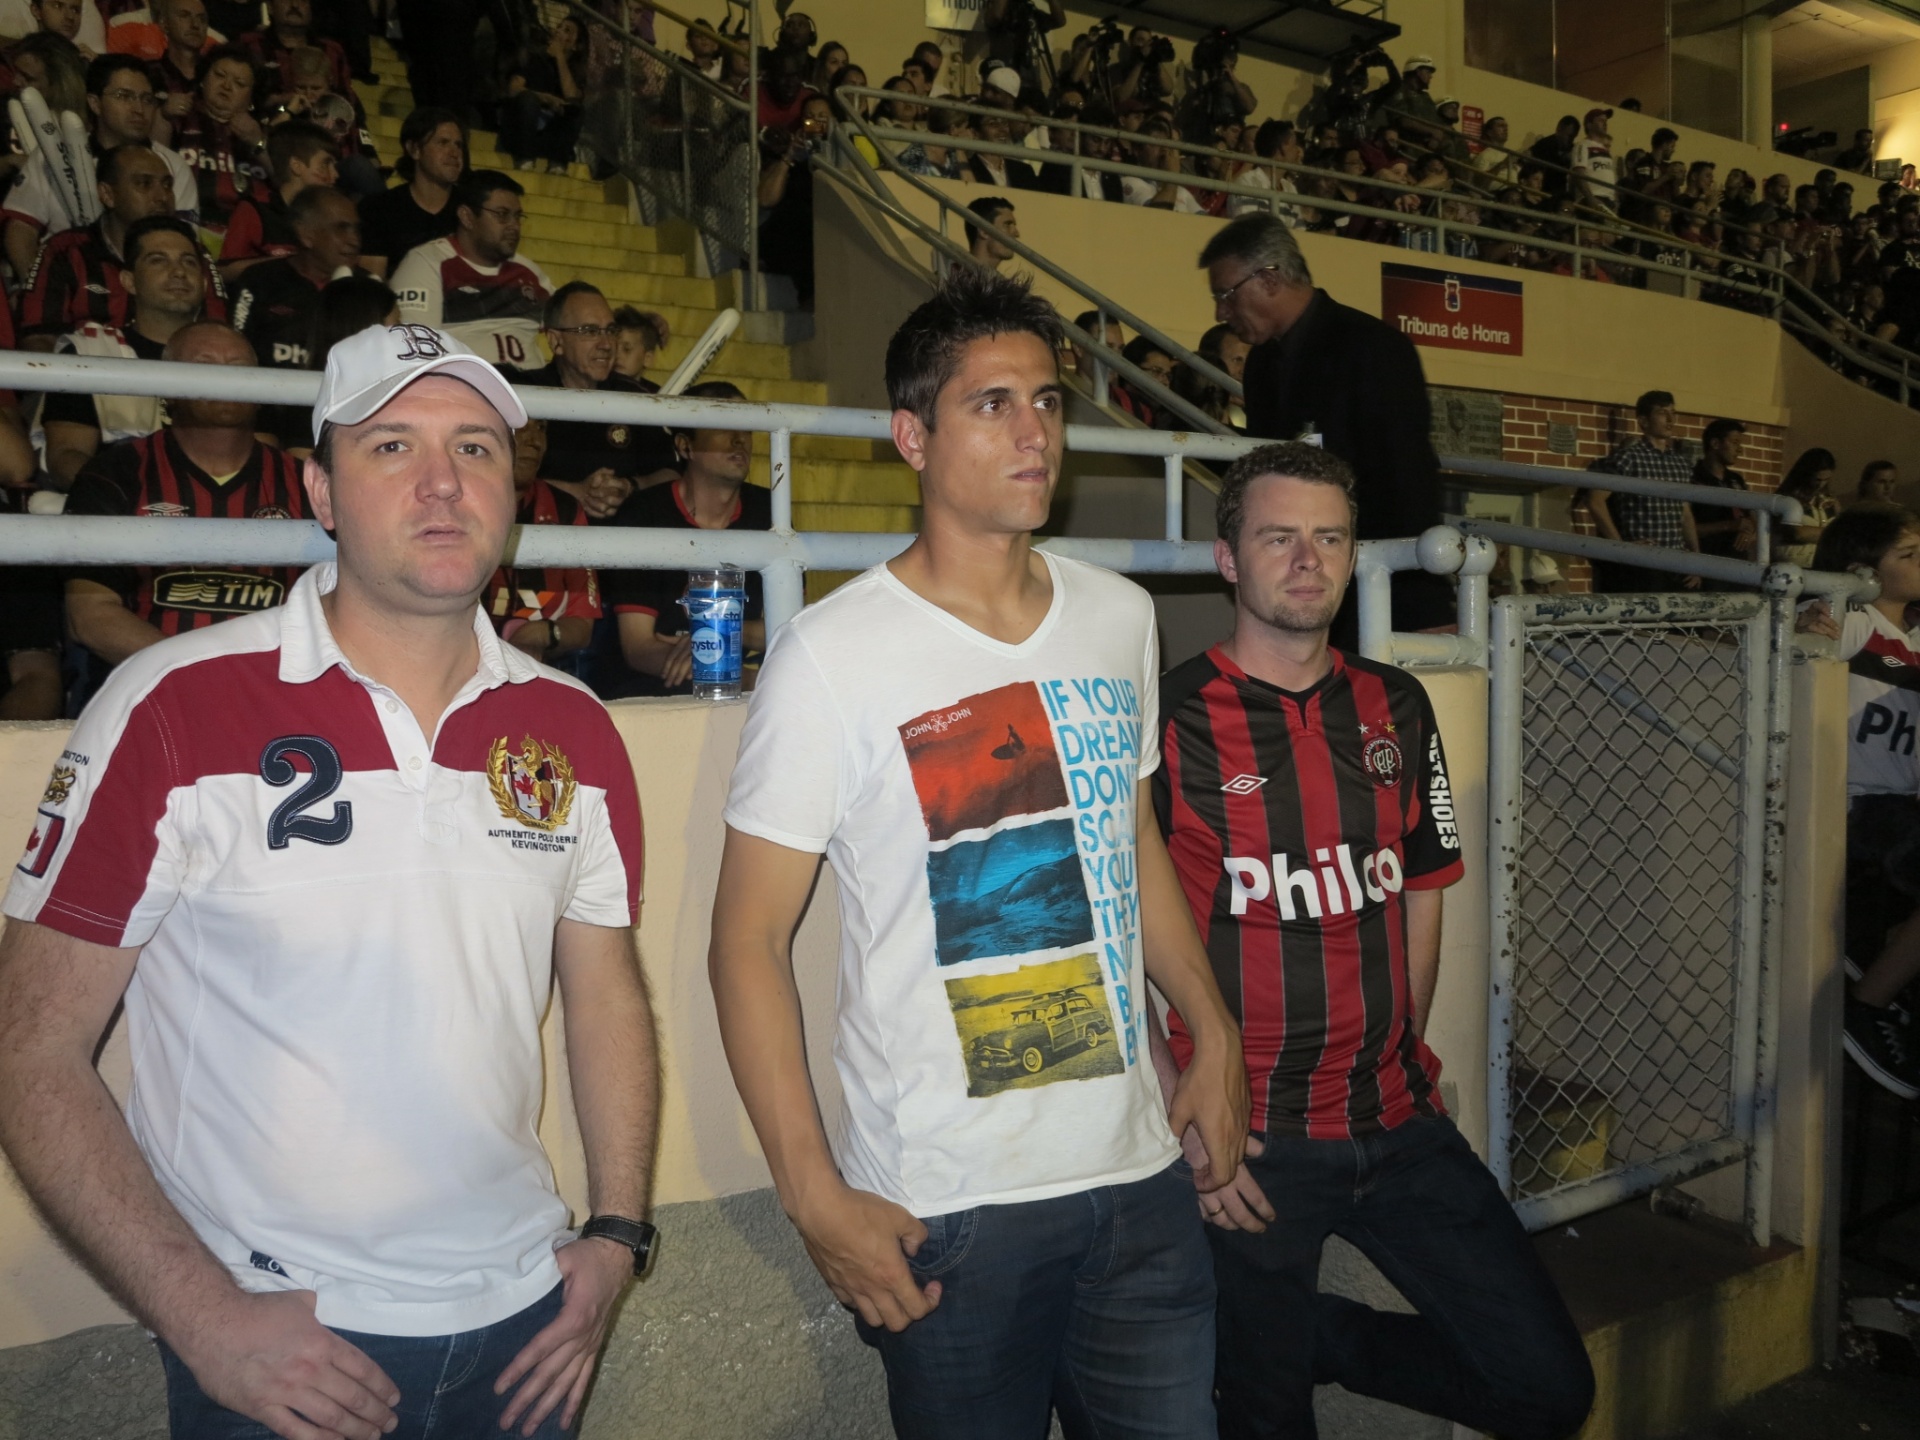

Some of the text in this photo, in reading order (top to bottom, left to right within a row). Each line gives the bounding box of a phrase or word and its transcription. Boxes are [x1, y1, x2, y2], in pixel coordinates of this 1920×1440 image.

[1397, 315, 1511, 345] Tribuna de Honra
[493, 333, 525, 362] 10
[223, 584, 275, 608] TIM
[691, 639, 722, 652] rystal
[1041, 677, 1140, 721] IF YOUR
[905, 707, 972, 740] JOHN JOHN
[259, 734, 353, 850] 2
[488, 829, 536, 841] AUTHENTIC
[538, 832, 554, 843] POLO
[511, 839, 566, 852] KEVINGSTON
[1084, 851, 1134, 895] YOU
[1222, 843, 1404, 921] Philco
